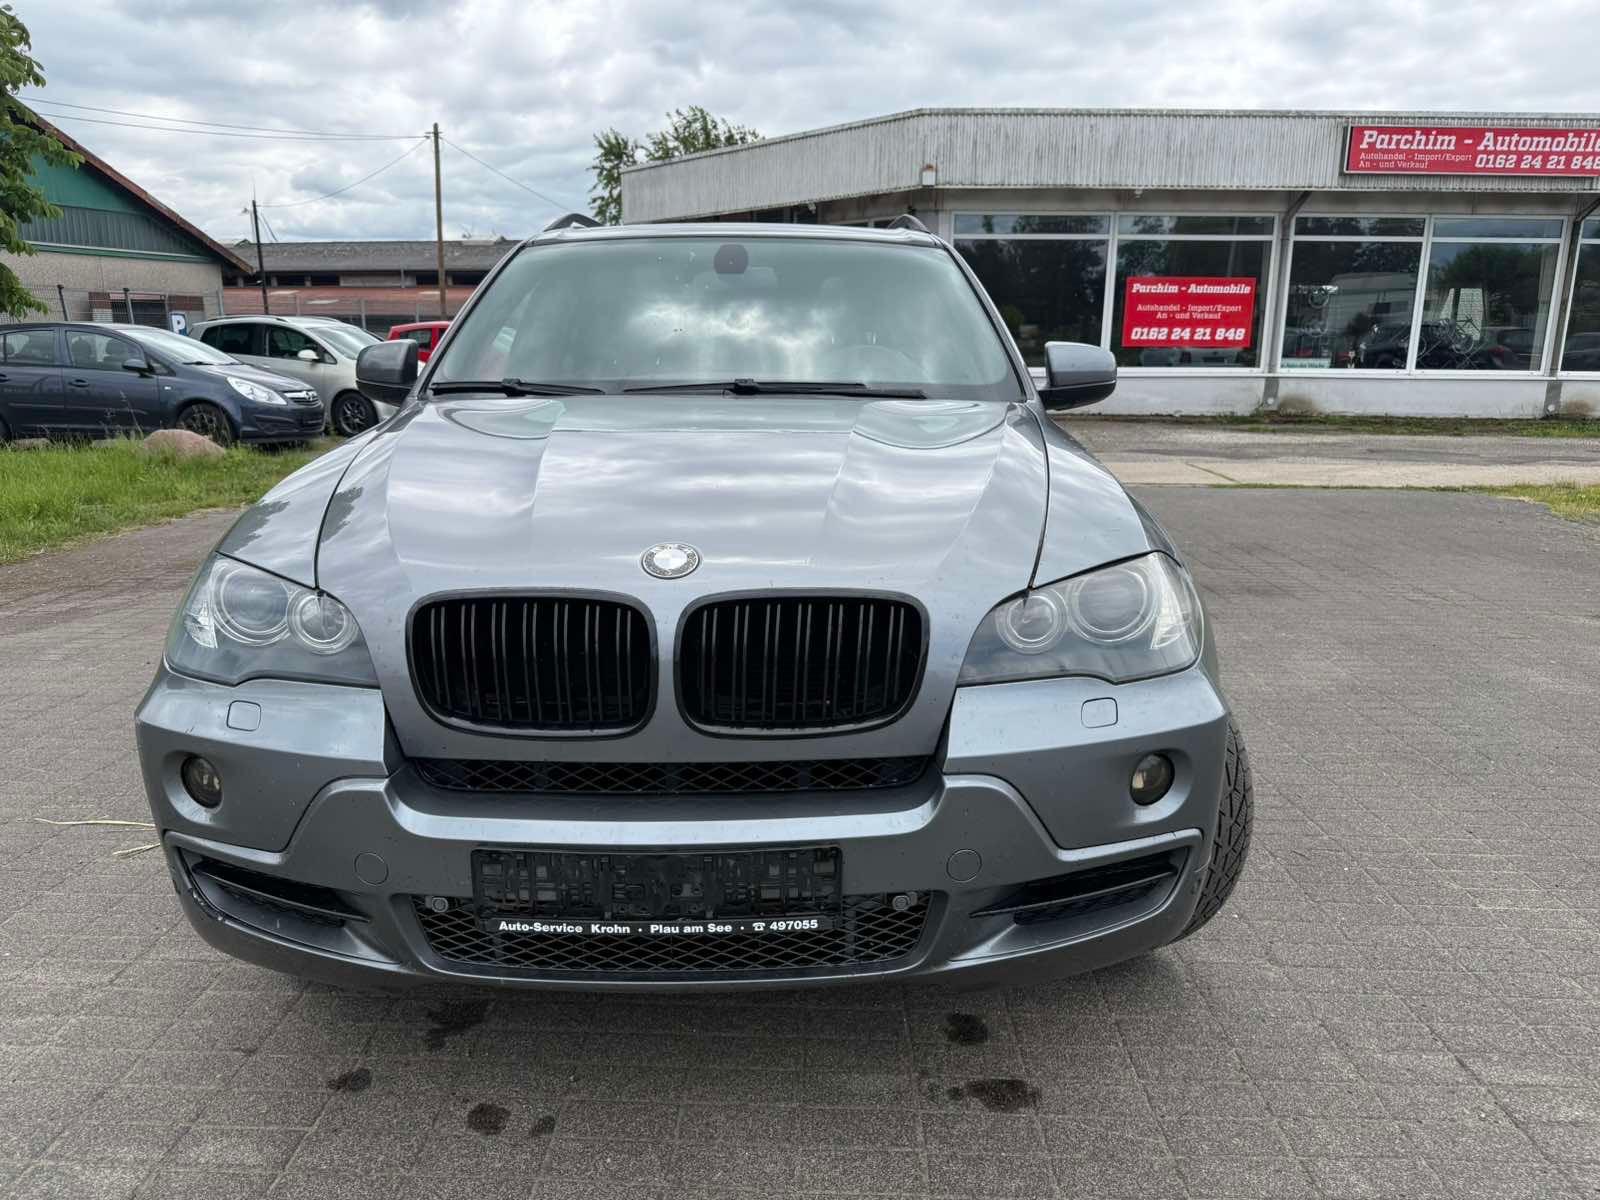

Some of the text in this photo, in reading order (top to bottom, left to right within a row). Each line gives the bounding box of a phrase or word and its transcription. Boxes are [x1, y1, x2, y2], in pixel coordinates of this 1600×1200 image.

[1360, 130, 1456, 150] Parchim
[1414, 153, 1472, 162] Import/Export
[1475, 154, 1517, 168] 0162
[1520, 155, 1543, 169] 24
[1546, 155, 1566, 169] 21
[1132, 284, 1178, 293] Parchim
[1188, 284, 1251, 294] Automobile
[1137, 304, 1180, 312] Autohandel
[1187, 304, 1241, 312] Import/Export
[1192, 312, 1222, 320] Verkauf
[1131, 328, 1246, 340] 0162 24 21 848
[499, 919, 819, 934] Auto-Service Krohn Plau am See 497055
